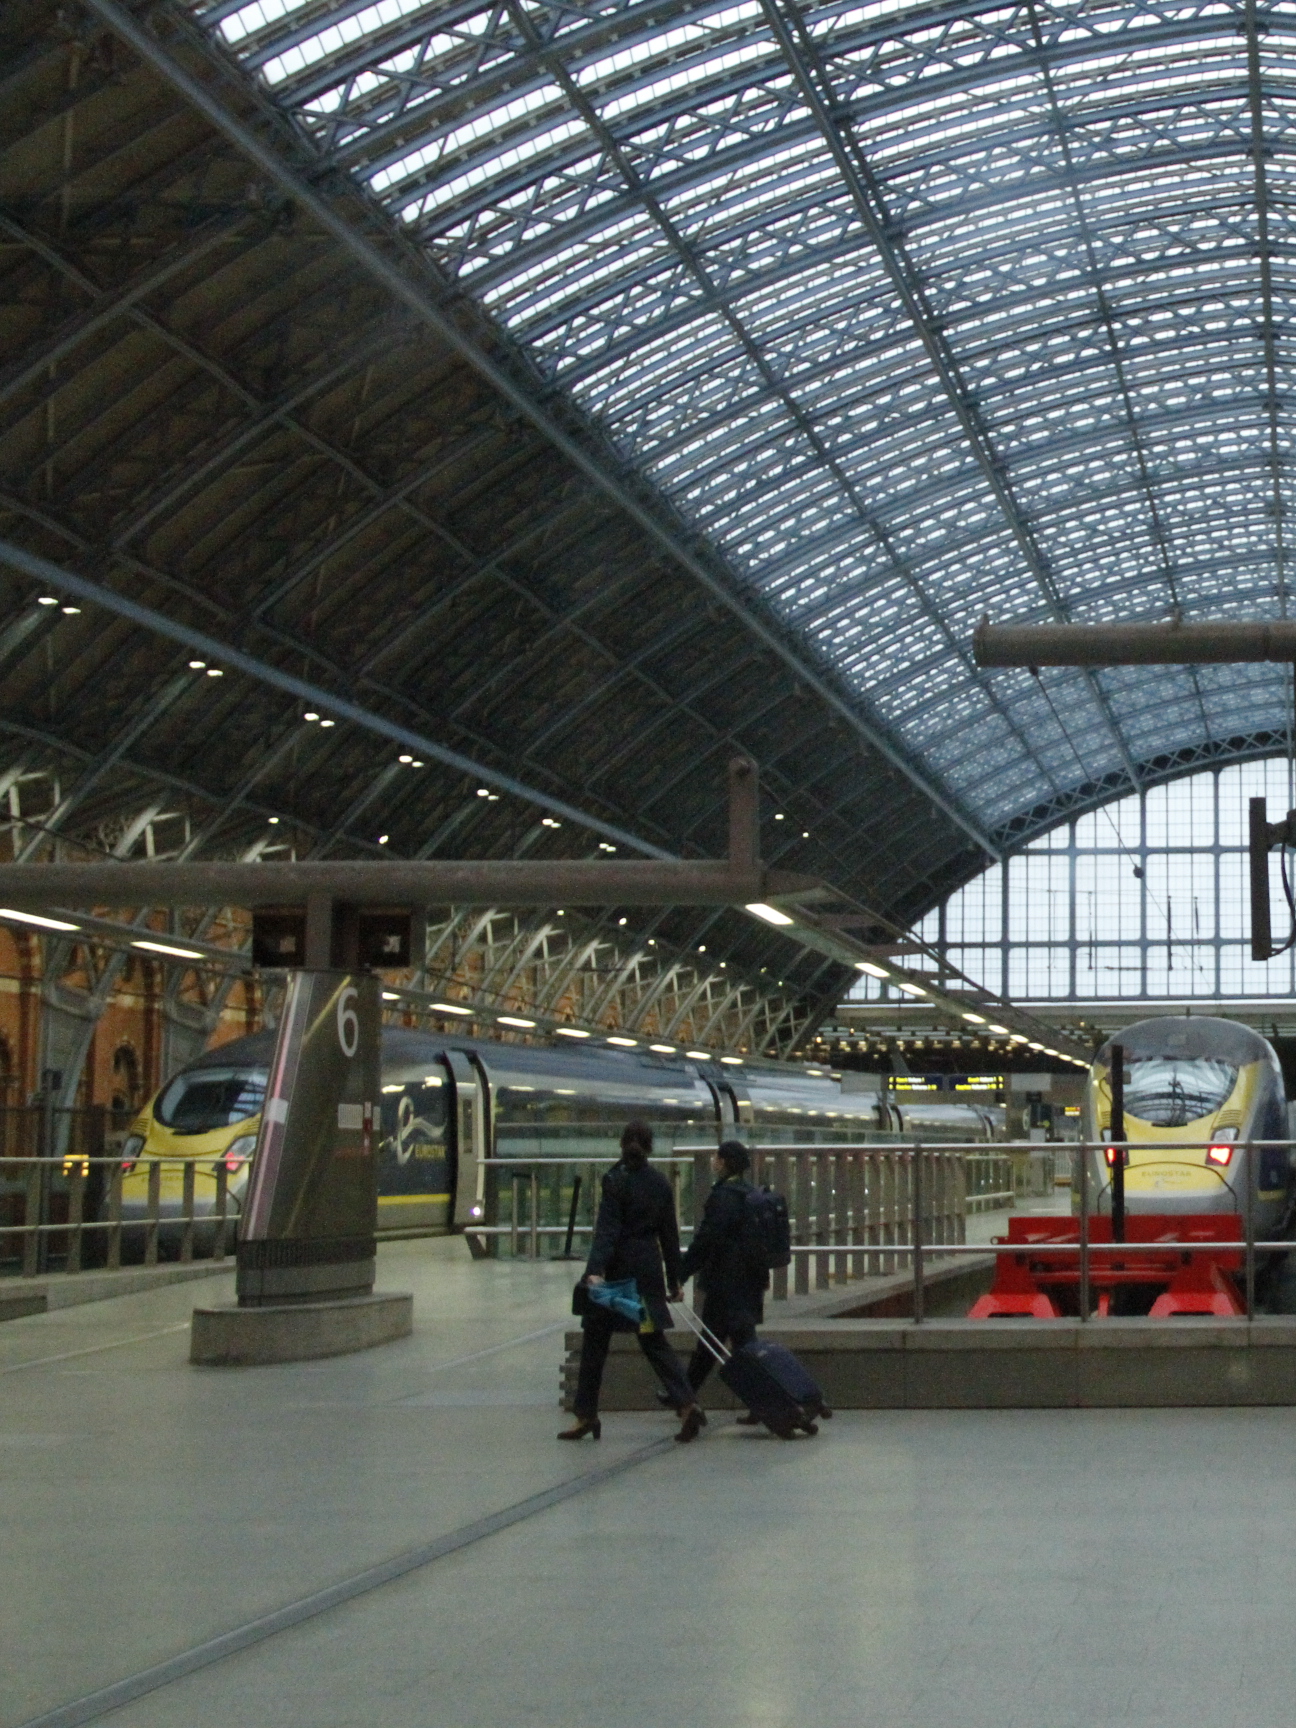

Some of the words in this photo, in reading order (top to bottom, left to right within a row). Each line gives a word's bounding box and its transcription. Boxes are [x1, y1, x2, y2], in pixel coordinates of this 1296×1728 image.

[337, 987, 359, 1057] 6
[415, 1143, 448, 1159] EUROSTAR
[1141, 1170, 1192, 1178] EUROSTAR
